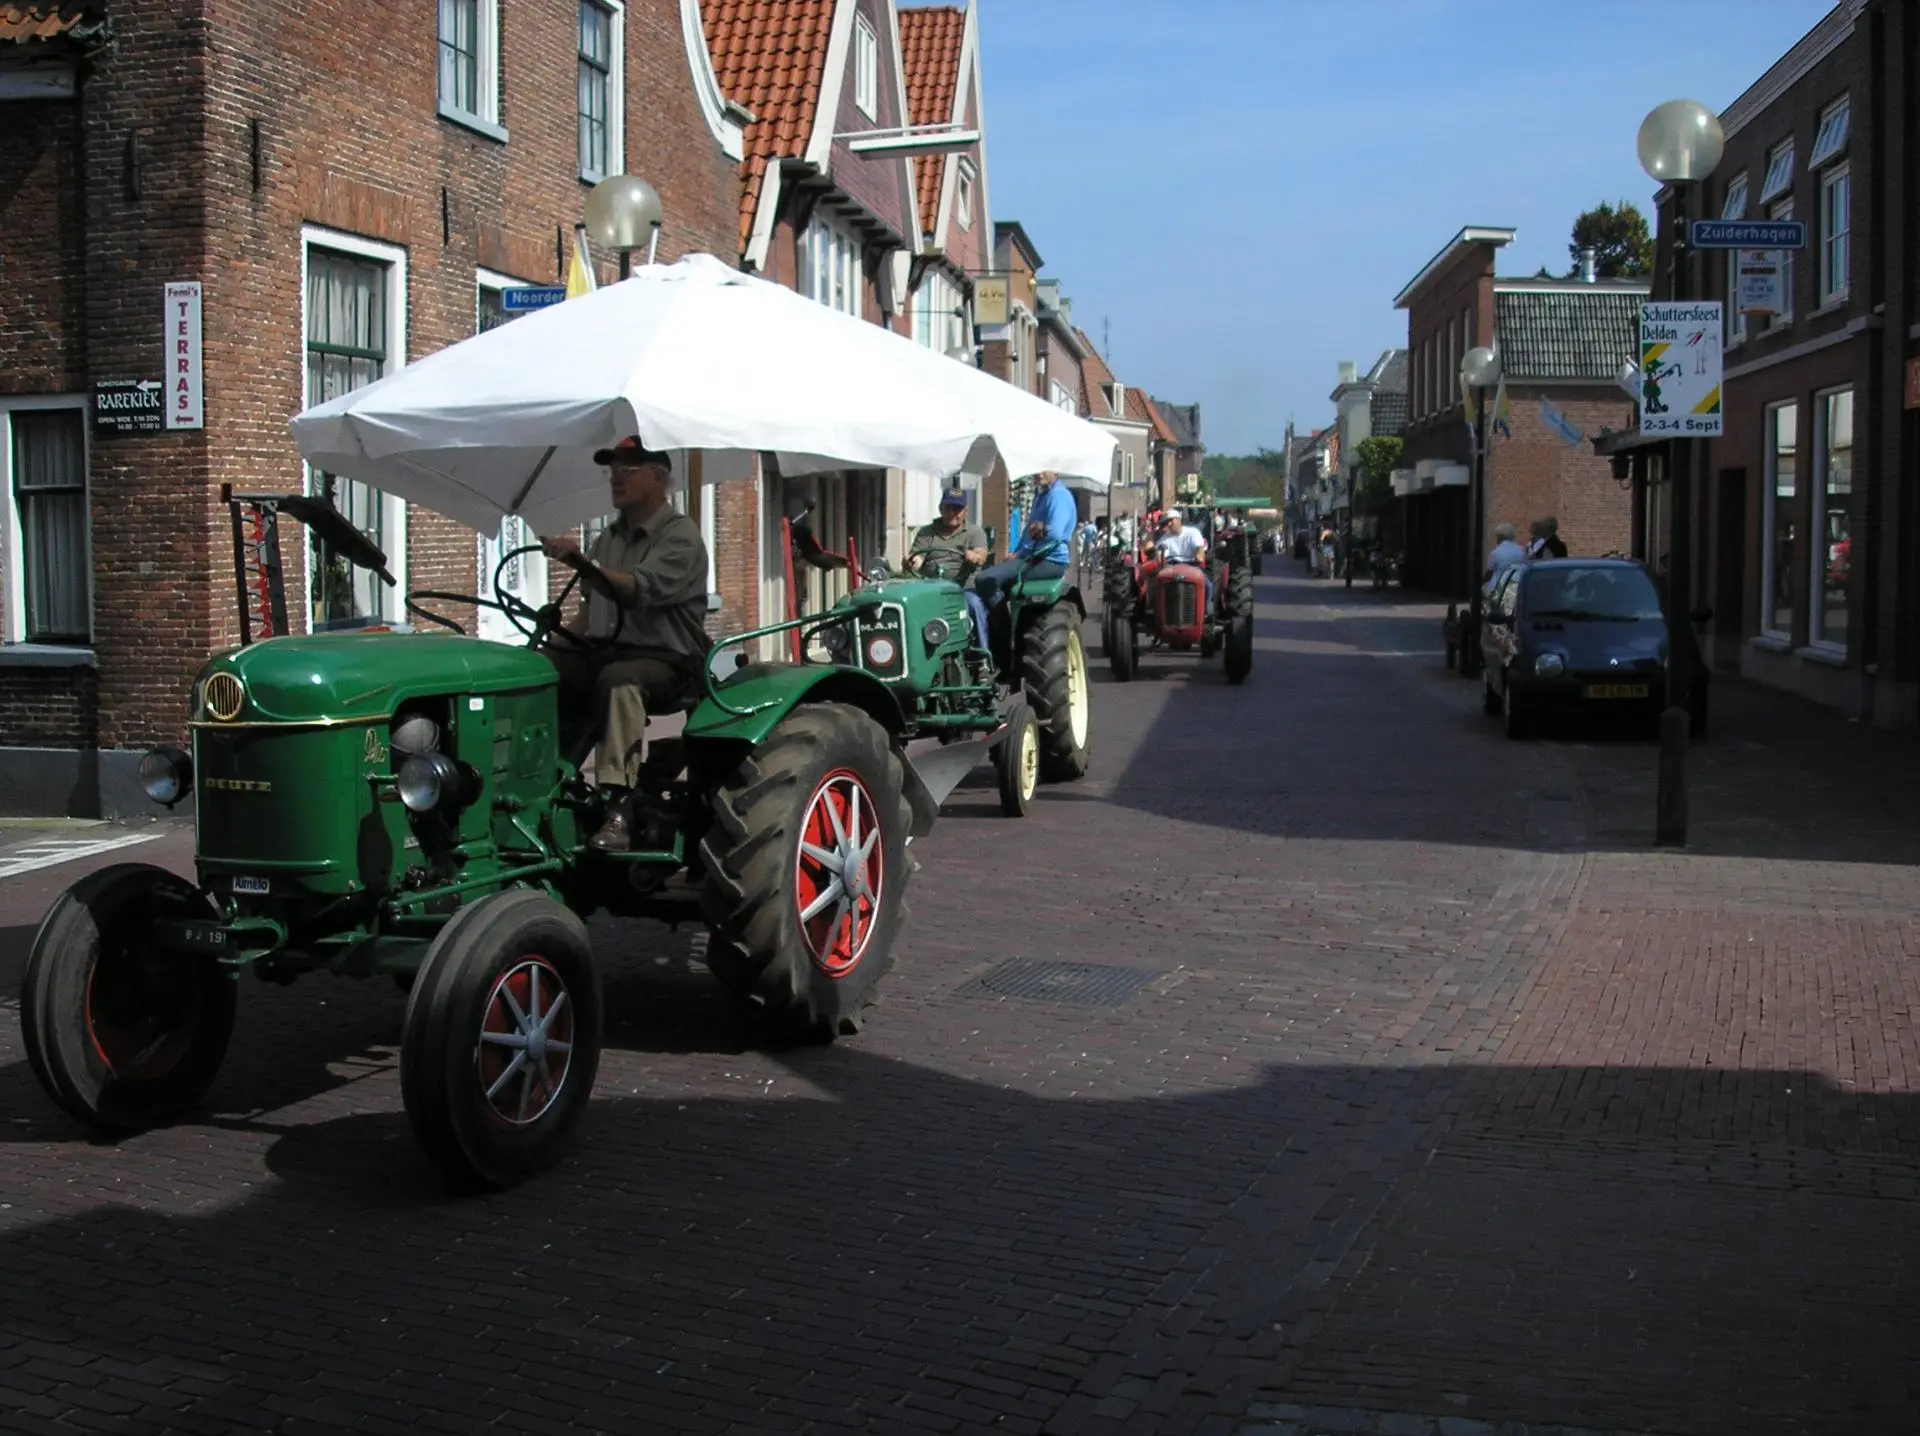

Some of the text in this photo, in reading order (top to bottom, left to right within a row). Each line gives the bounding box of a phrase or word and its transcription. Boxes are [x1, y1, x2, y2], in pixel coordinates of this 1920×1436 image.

[1701, 226, 1796, 241] Zuiderhagen
[1642, 305, 1720, 322] Schuttersfeest
[1642, 325, 1678, 340] Delden
[176, 302, 189, 410] TERRAS
[97, 391, 160, 409] RAREKIEK
[1644, 419, 1720, 432] 2-3-4 Sept
